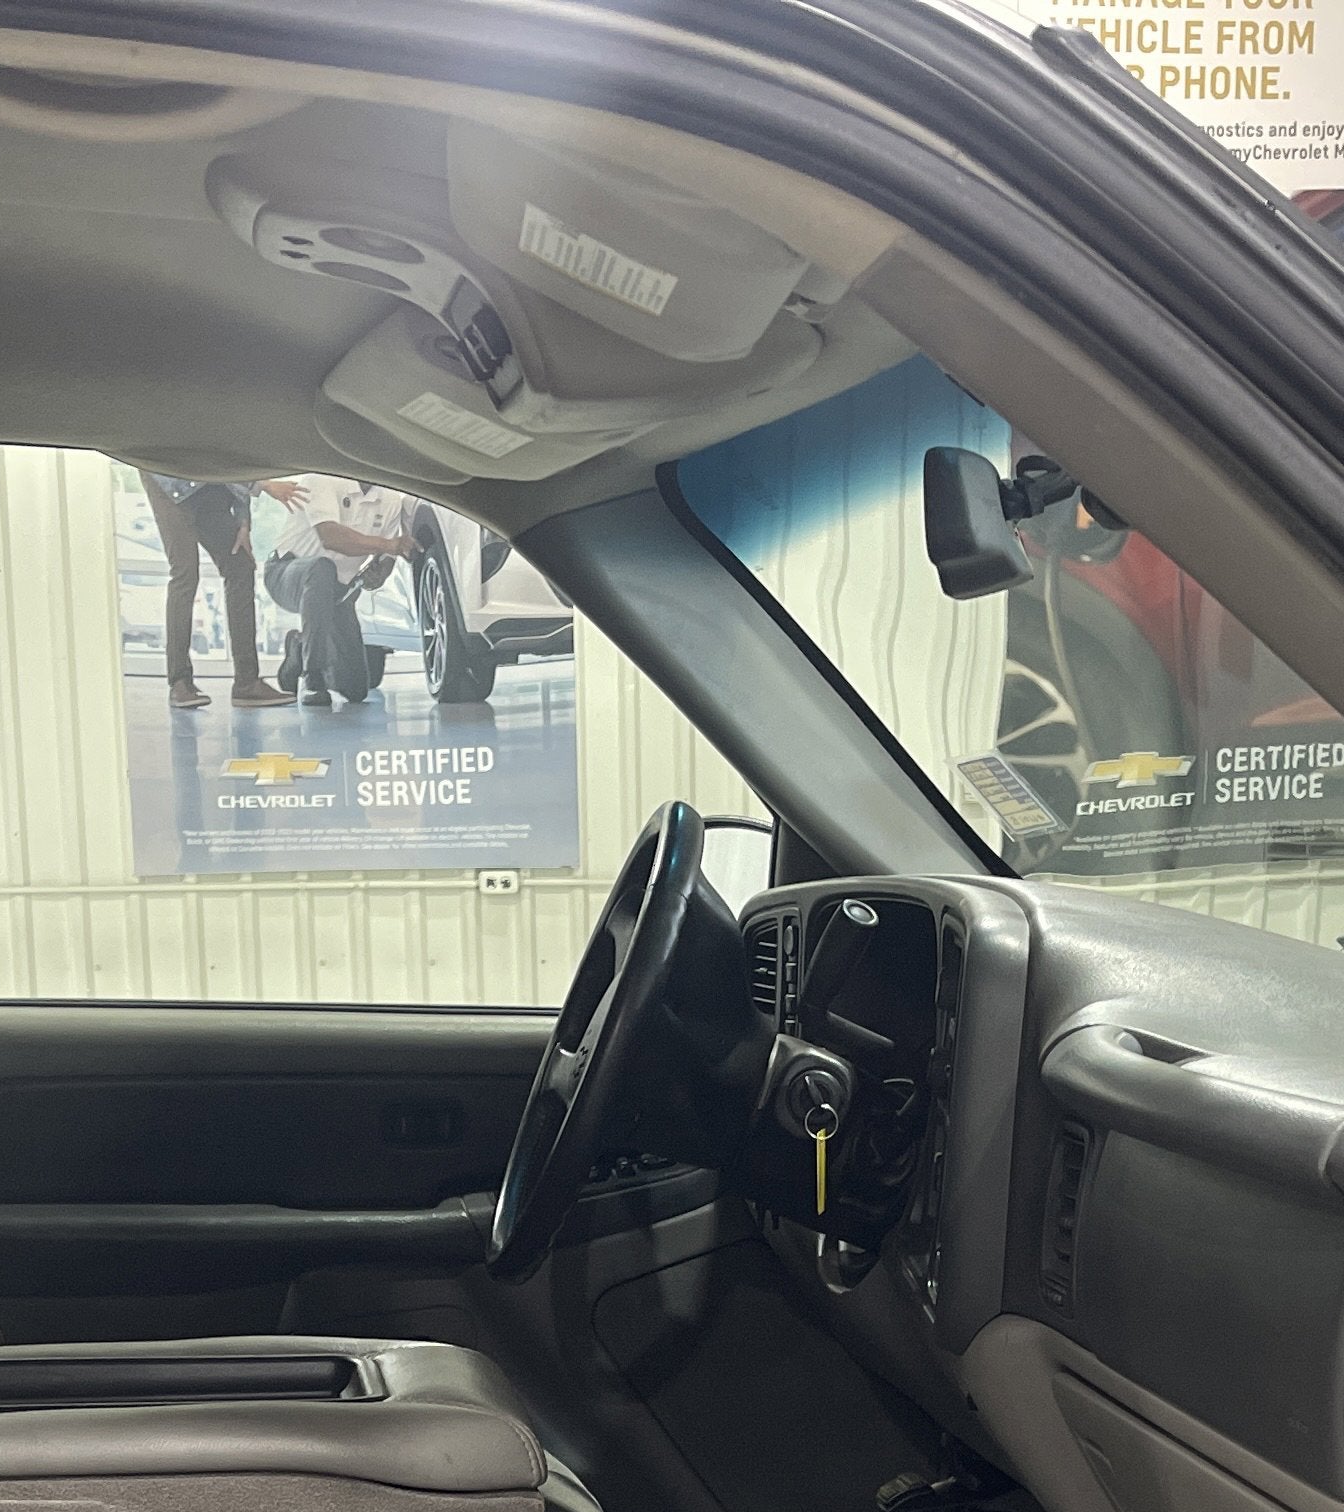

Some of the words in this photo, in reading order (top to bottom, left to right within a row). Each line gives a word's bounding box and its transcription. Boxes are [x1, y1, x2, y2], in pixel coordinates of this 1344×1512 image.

[1050, 17, 1203, 55] HICLE
[1217, 20, 1315, 55] FROM
[1159, 66, 1291, 100] PHONE.
[1199, 121, 1264, 138] nostics
[1268, 121, 1298, 138] and
[1302, 121, 1344, 141] enjoy
[355, 745, 495, 777] CERTIFIED
[217, 793, 337, 810] CHEVROLET
[356, 778, 473, 807] SERVICE
[1076, 791, 1195, 816] CHEVROLET
[1214, 773, 1325, 804] SERVICE
